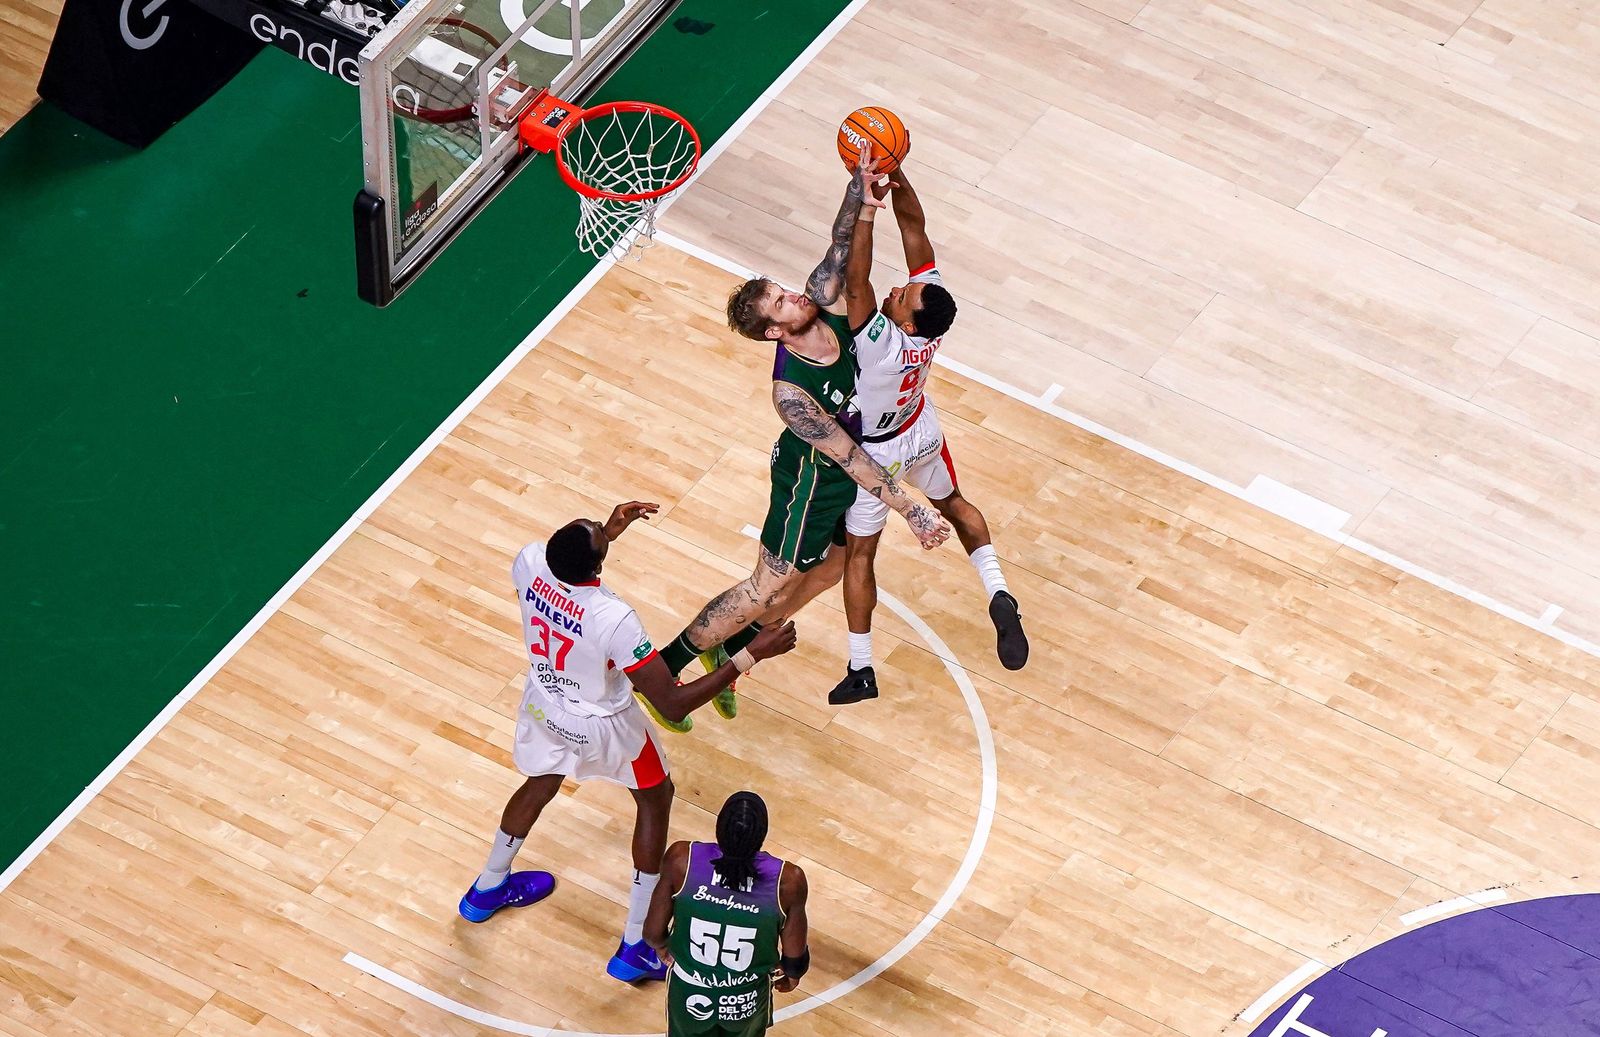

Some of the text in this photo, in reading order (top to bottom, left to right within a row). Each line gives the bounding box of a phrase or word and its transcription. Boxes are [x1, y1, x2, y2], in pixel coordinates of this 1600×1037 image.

[249, 13, 420, 115] endea
[405, 202, 437, 237] endesa
[525, 587, 583, 638] PULEVA
[532, 575, 586, 621] BRIMAH
[530, 615, 575, 672] 37
[689, 916, 758, 972] 55
[718, 990, 758, 1005] COSTA
[718, 999, 757, 1014] DEL SOL
[718, 1007, 757, 1021] MÁLAGA
